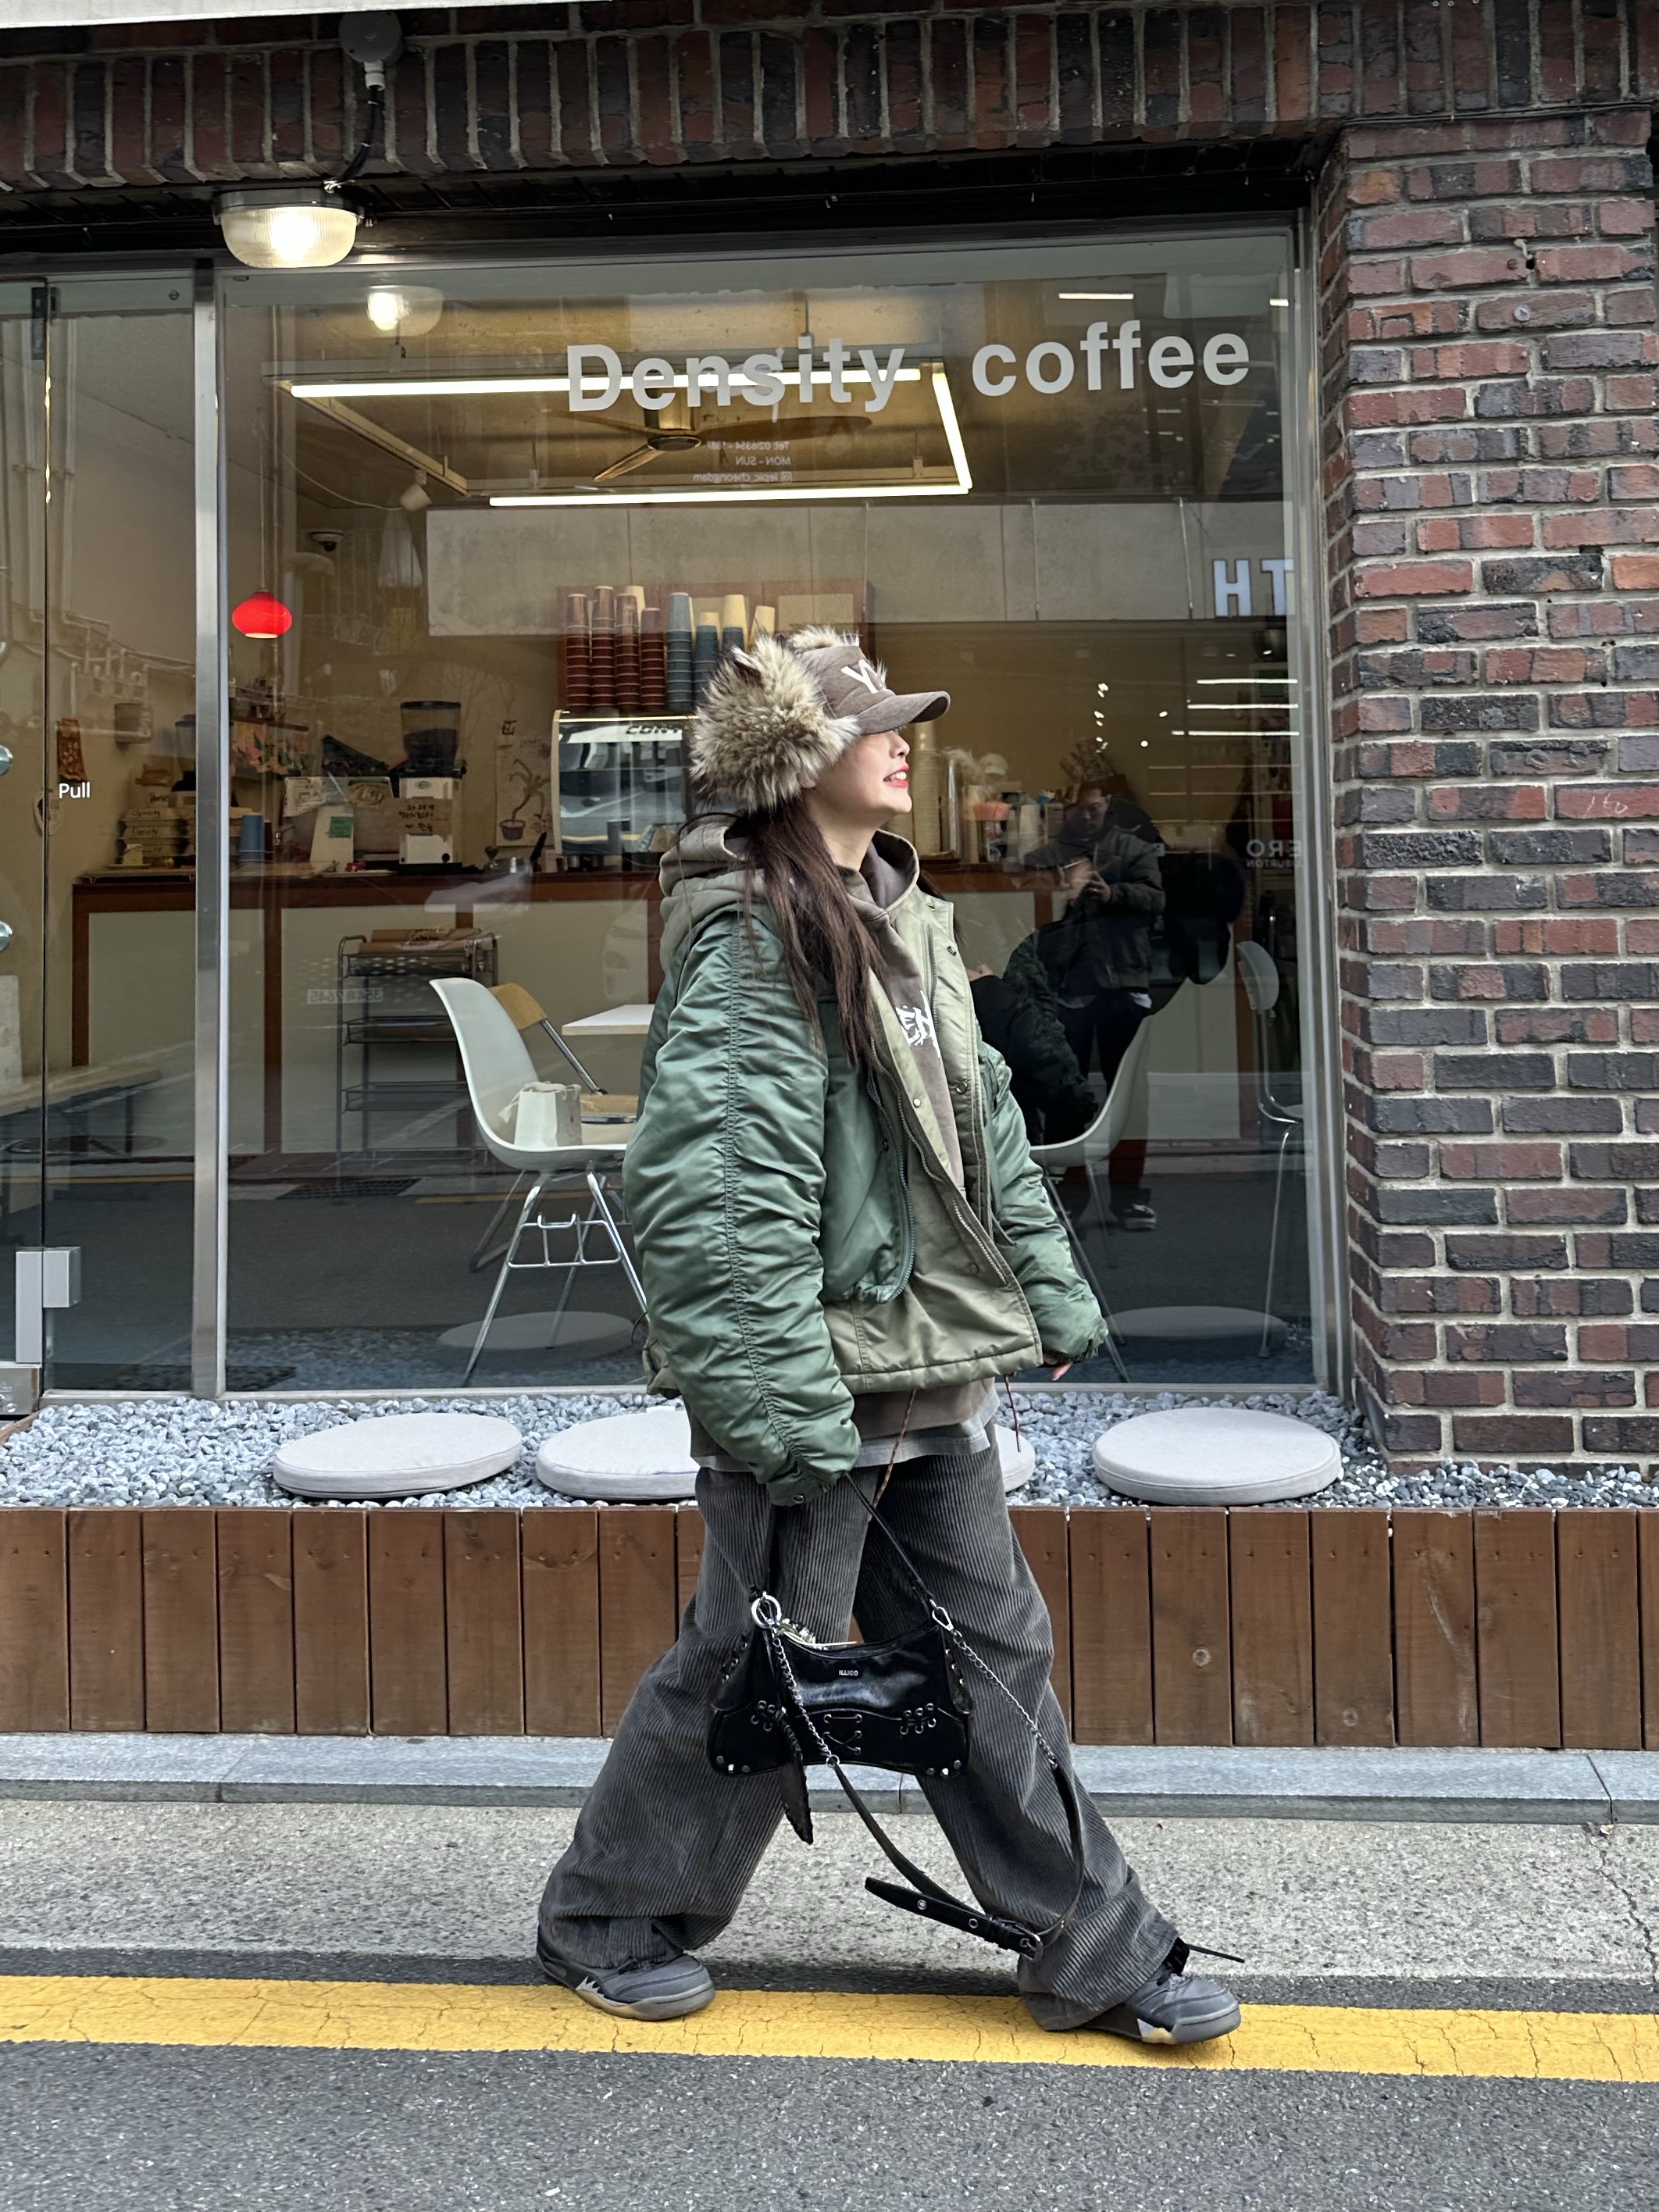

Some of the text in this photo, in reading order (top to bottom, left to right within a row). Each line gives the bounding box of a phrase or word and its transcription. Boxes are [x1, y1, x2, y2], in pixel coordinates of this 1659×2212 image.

[566, 319, 1250, 413] Density coffee
[59, 781, 91, 798] Pull
